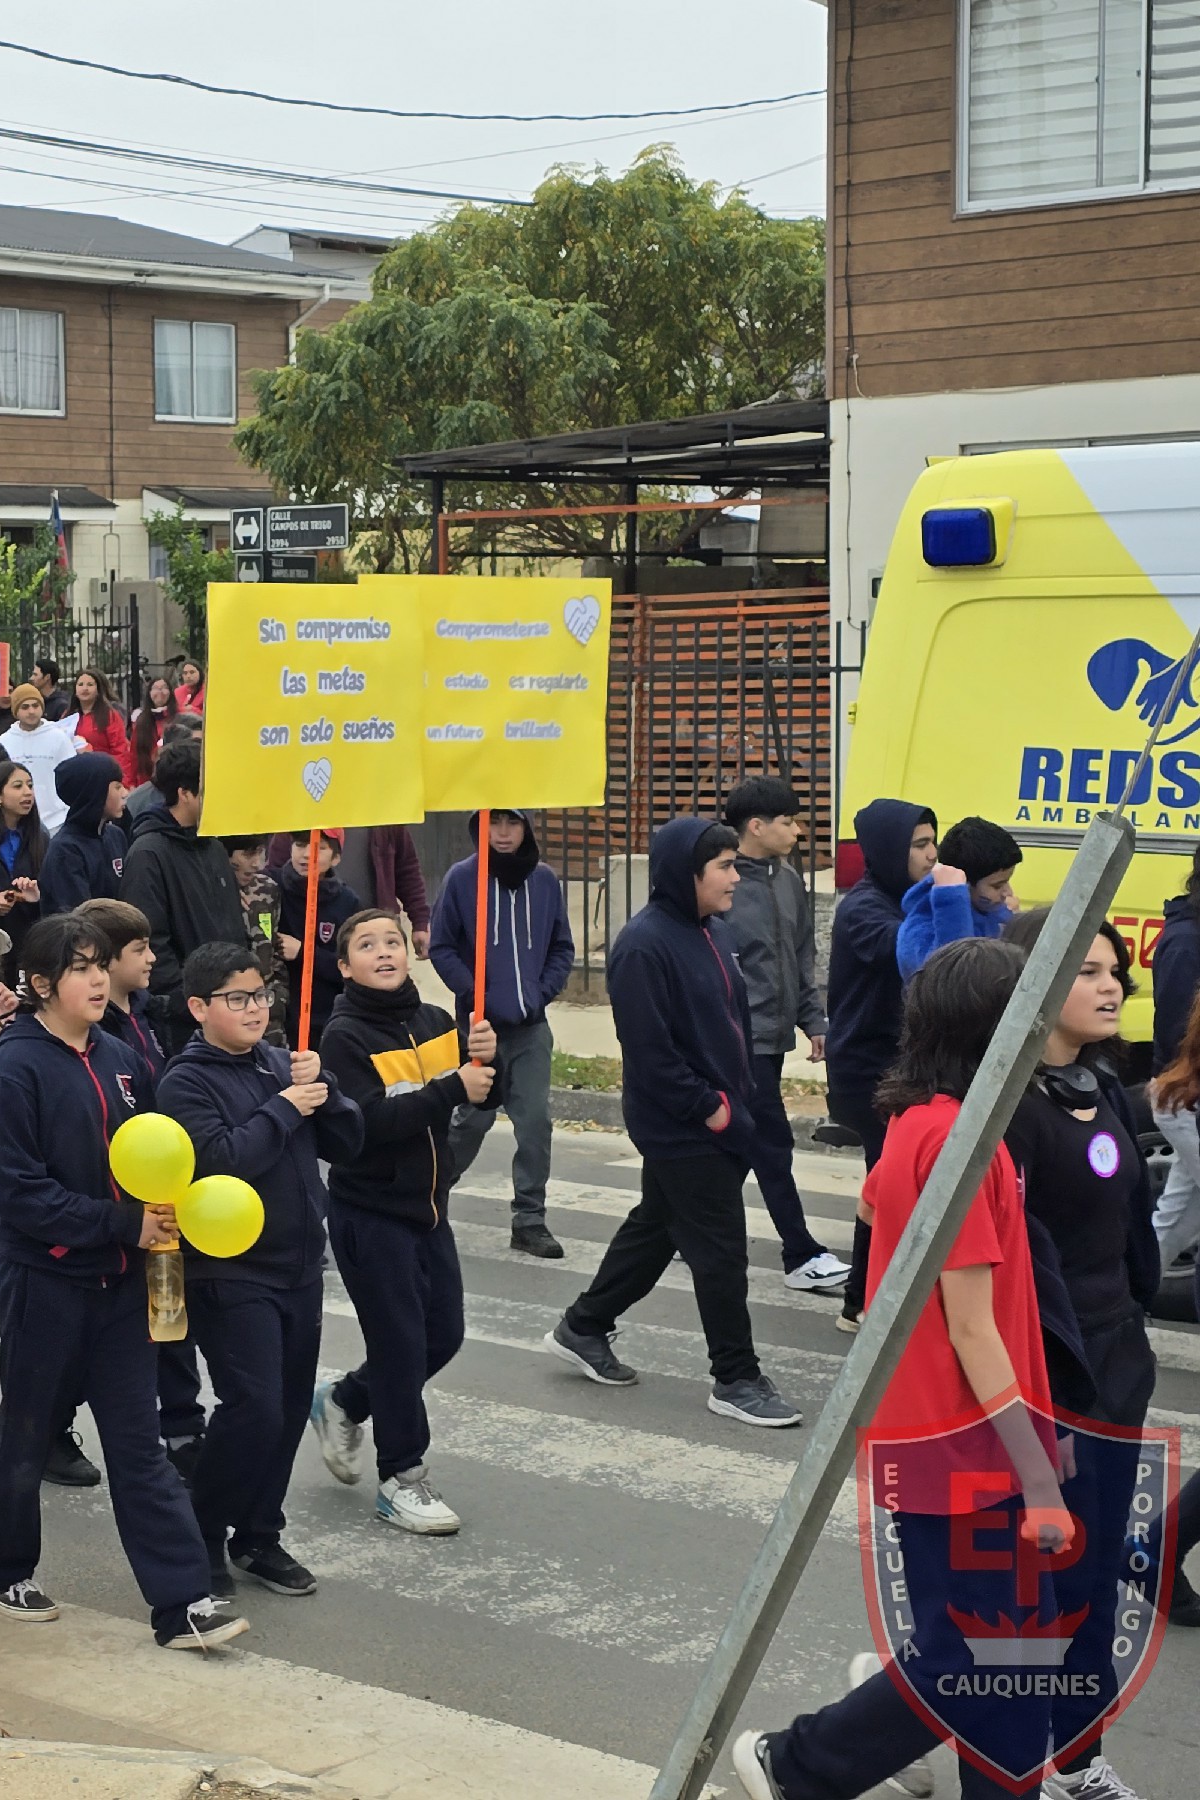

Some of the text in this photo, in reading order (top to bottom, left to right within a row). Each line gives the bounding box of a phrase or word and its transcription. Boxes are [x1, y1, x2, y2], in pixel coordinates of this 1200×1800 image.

[271, 511, 291, 521] CALLE
[271, 520, 332, 531] CAMPOS DE TRIGO
[259, 617, 391, 645] Sin compromiso
[436, 619, 550, 640] Comprometerse
[282, 666, 365, 694] las metas
[445, 673, 489, 688] estudio
[509, 675, 524, 688] es
[529, 673, 588, 694] regalarte
[260, 717, 394, 745] son solo sueños
[427, 721, 561, 738] un futuro brillante
[1018, 746, 1200, 808] REDS
[1016, 805, 1200, 829] AMBLAN
